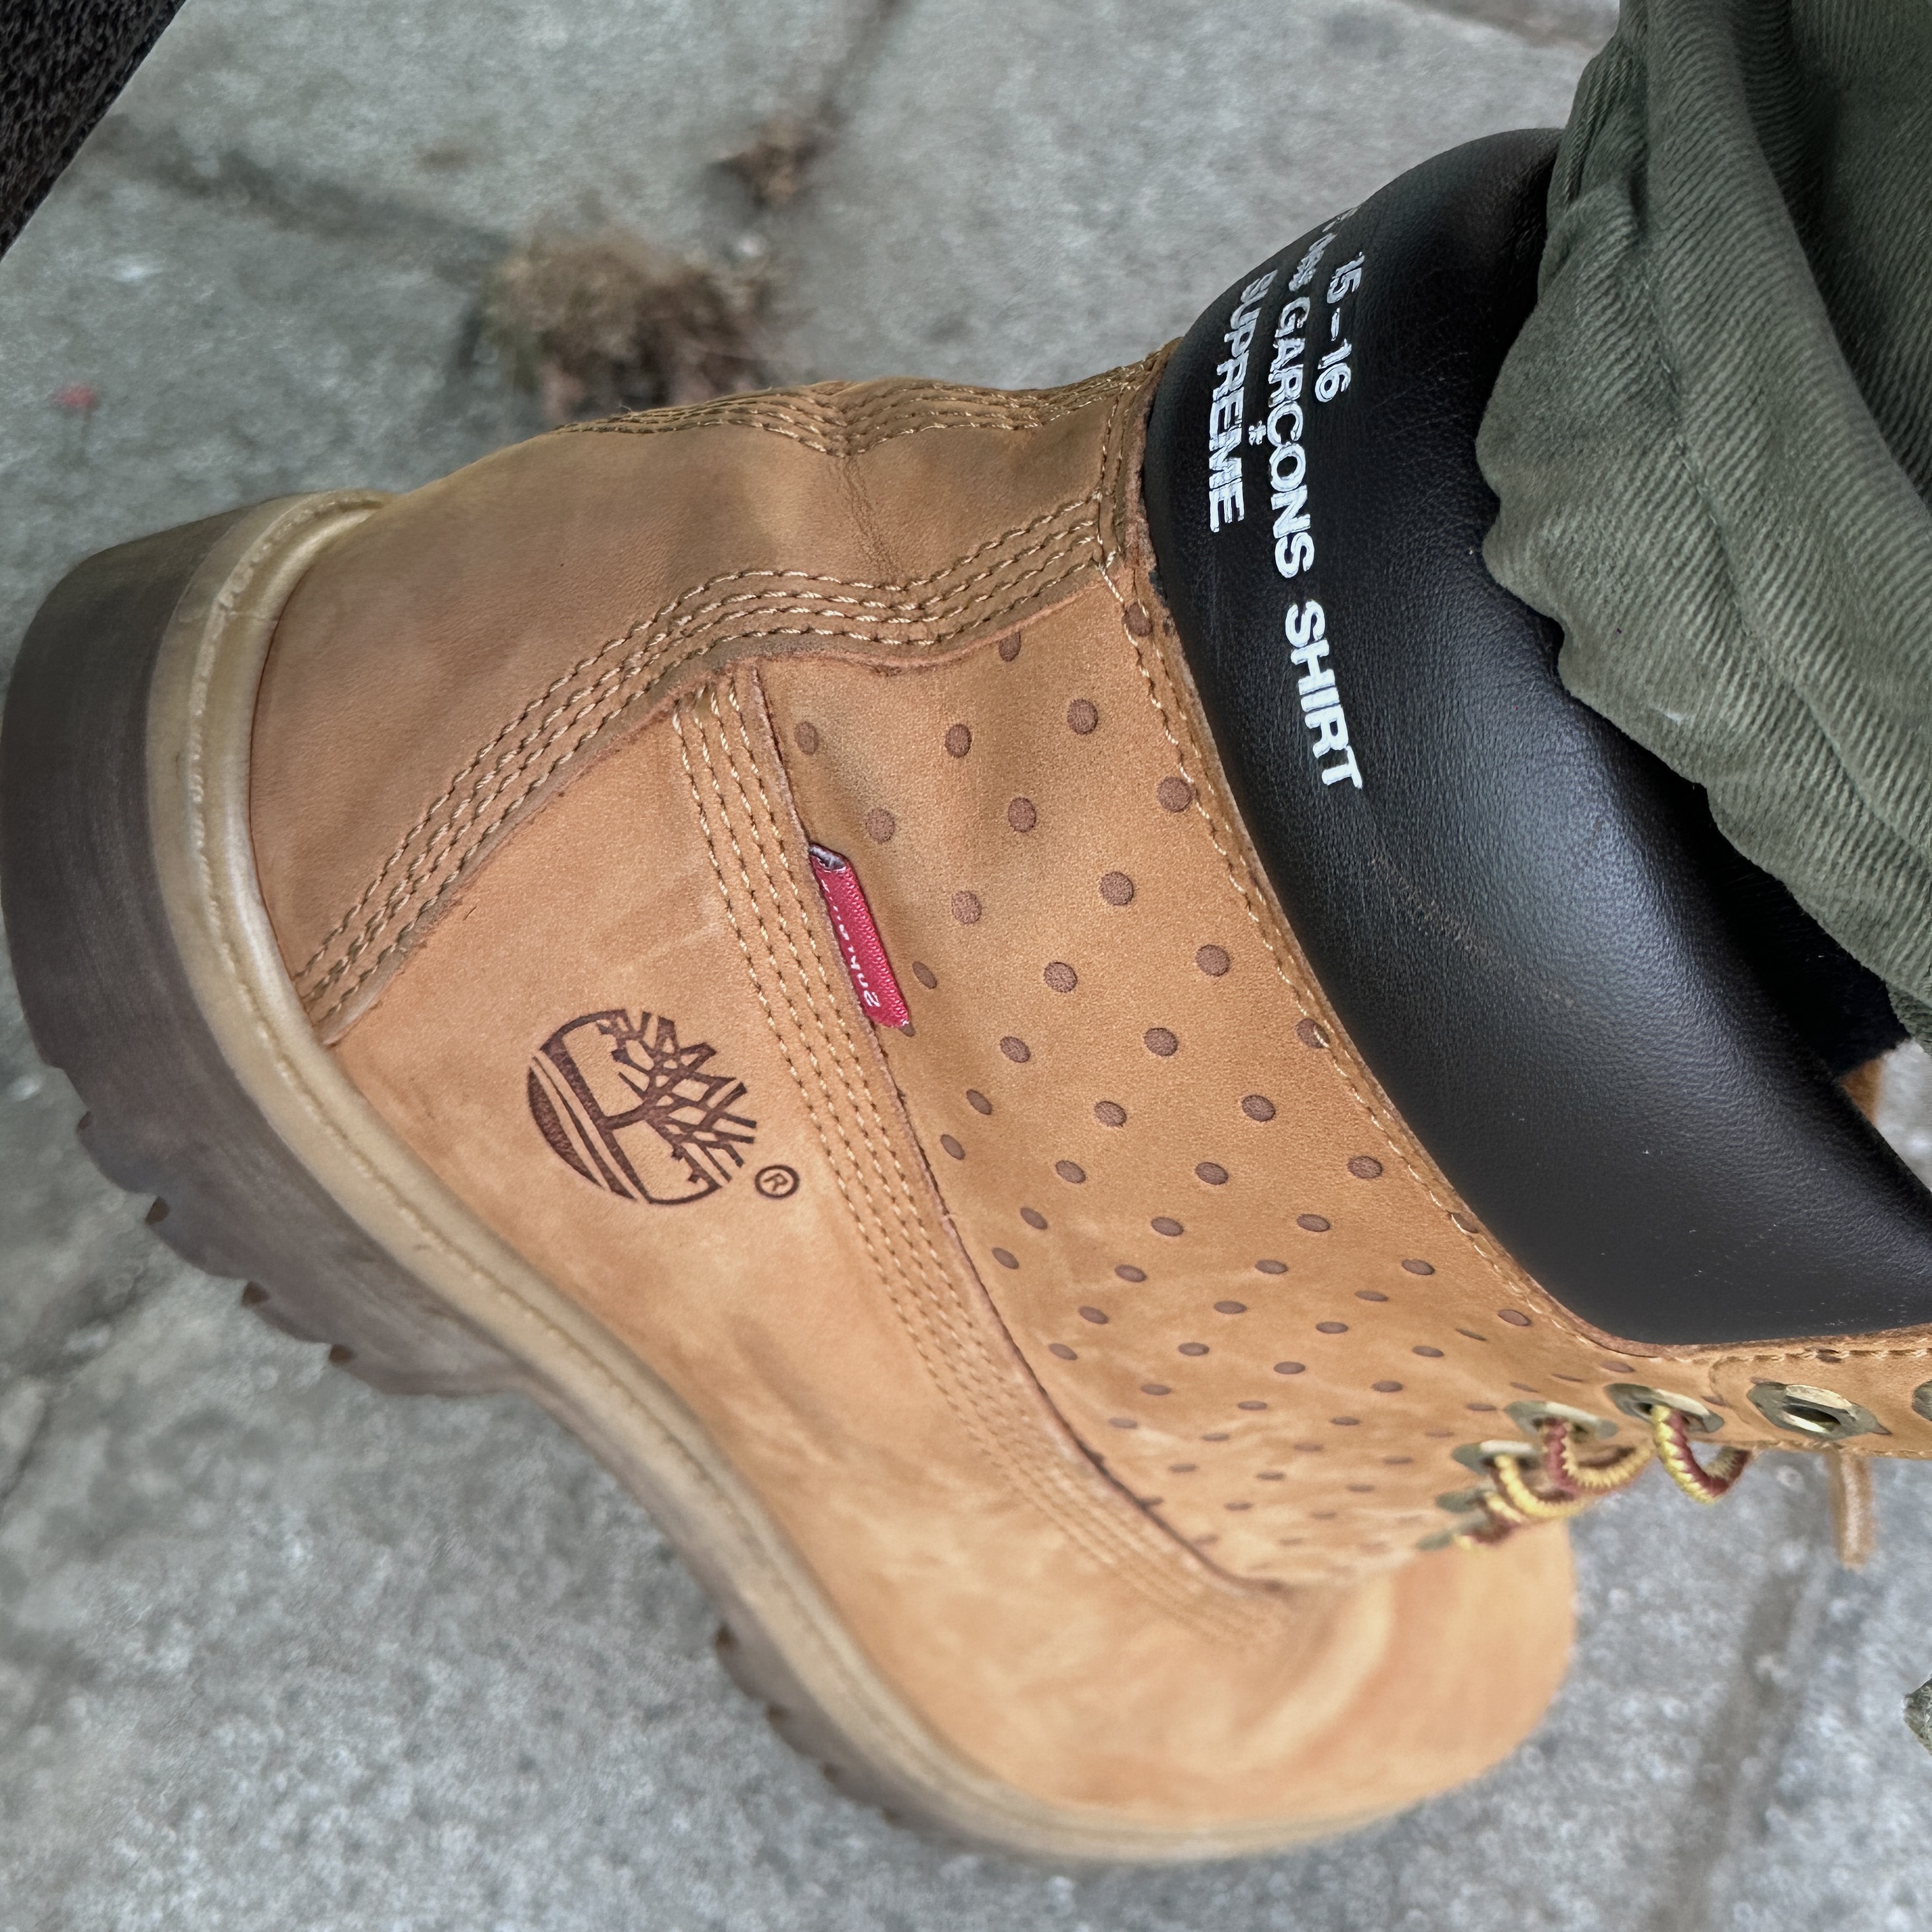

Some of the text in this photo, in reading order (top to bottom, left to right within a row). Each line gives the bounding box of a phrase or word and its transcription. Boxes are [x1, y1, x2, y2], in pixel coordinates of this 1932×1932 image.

[1208, 269, 1278, 533] SUPREME
[1248, 296, 1315, 578] GARÇONS
[1284, 599, 1363, 789] SHIRT
